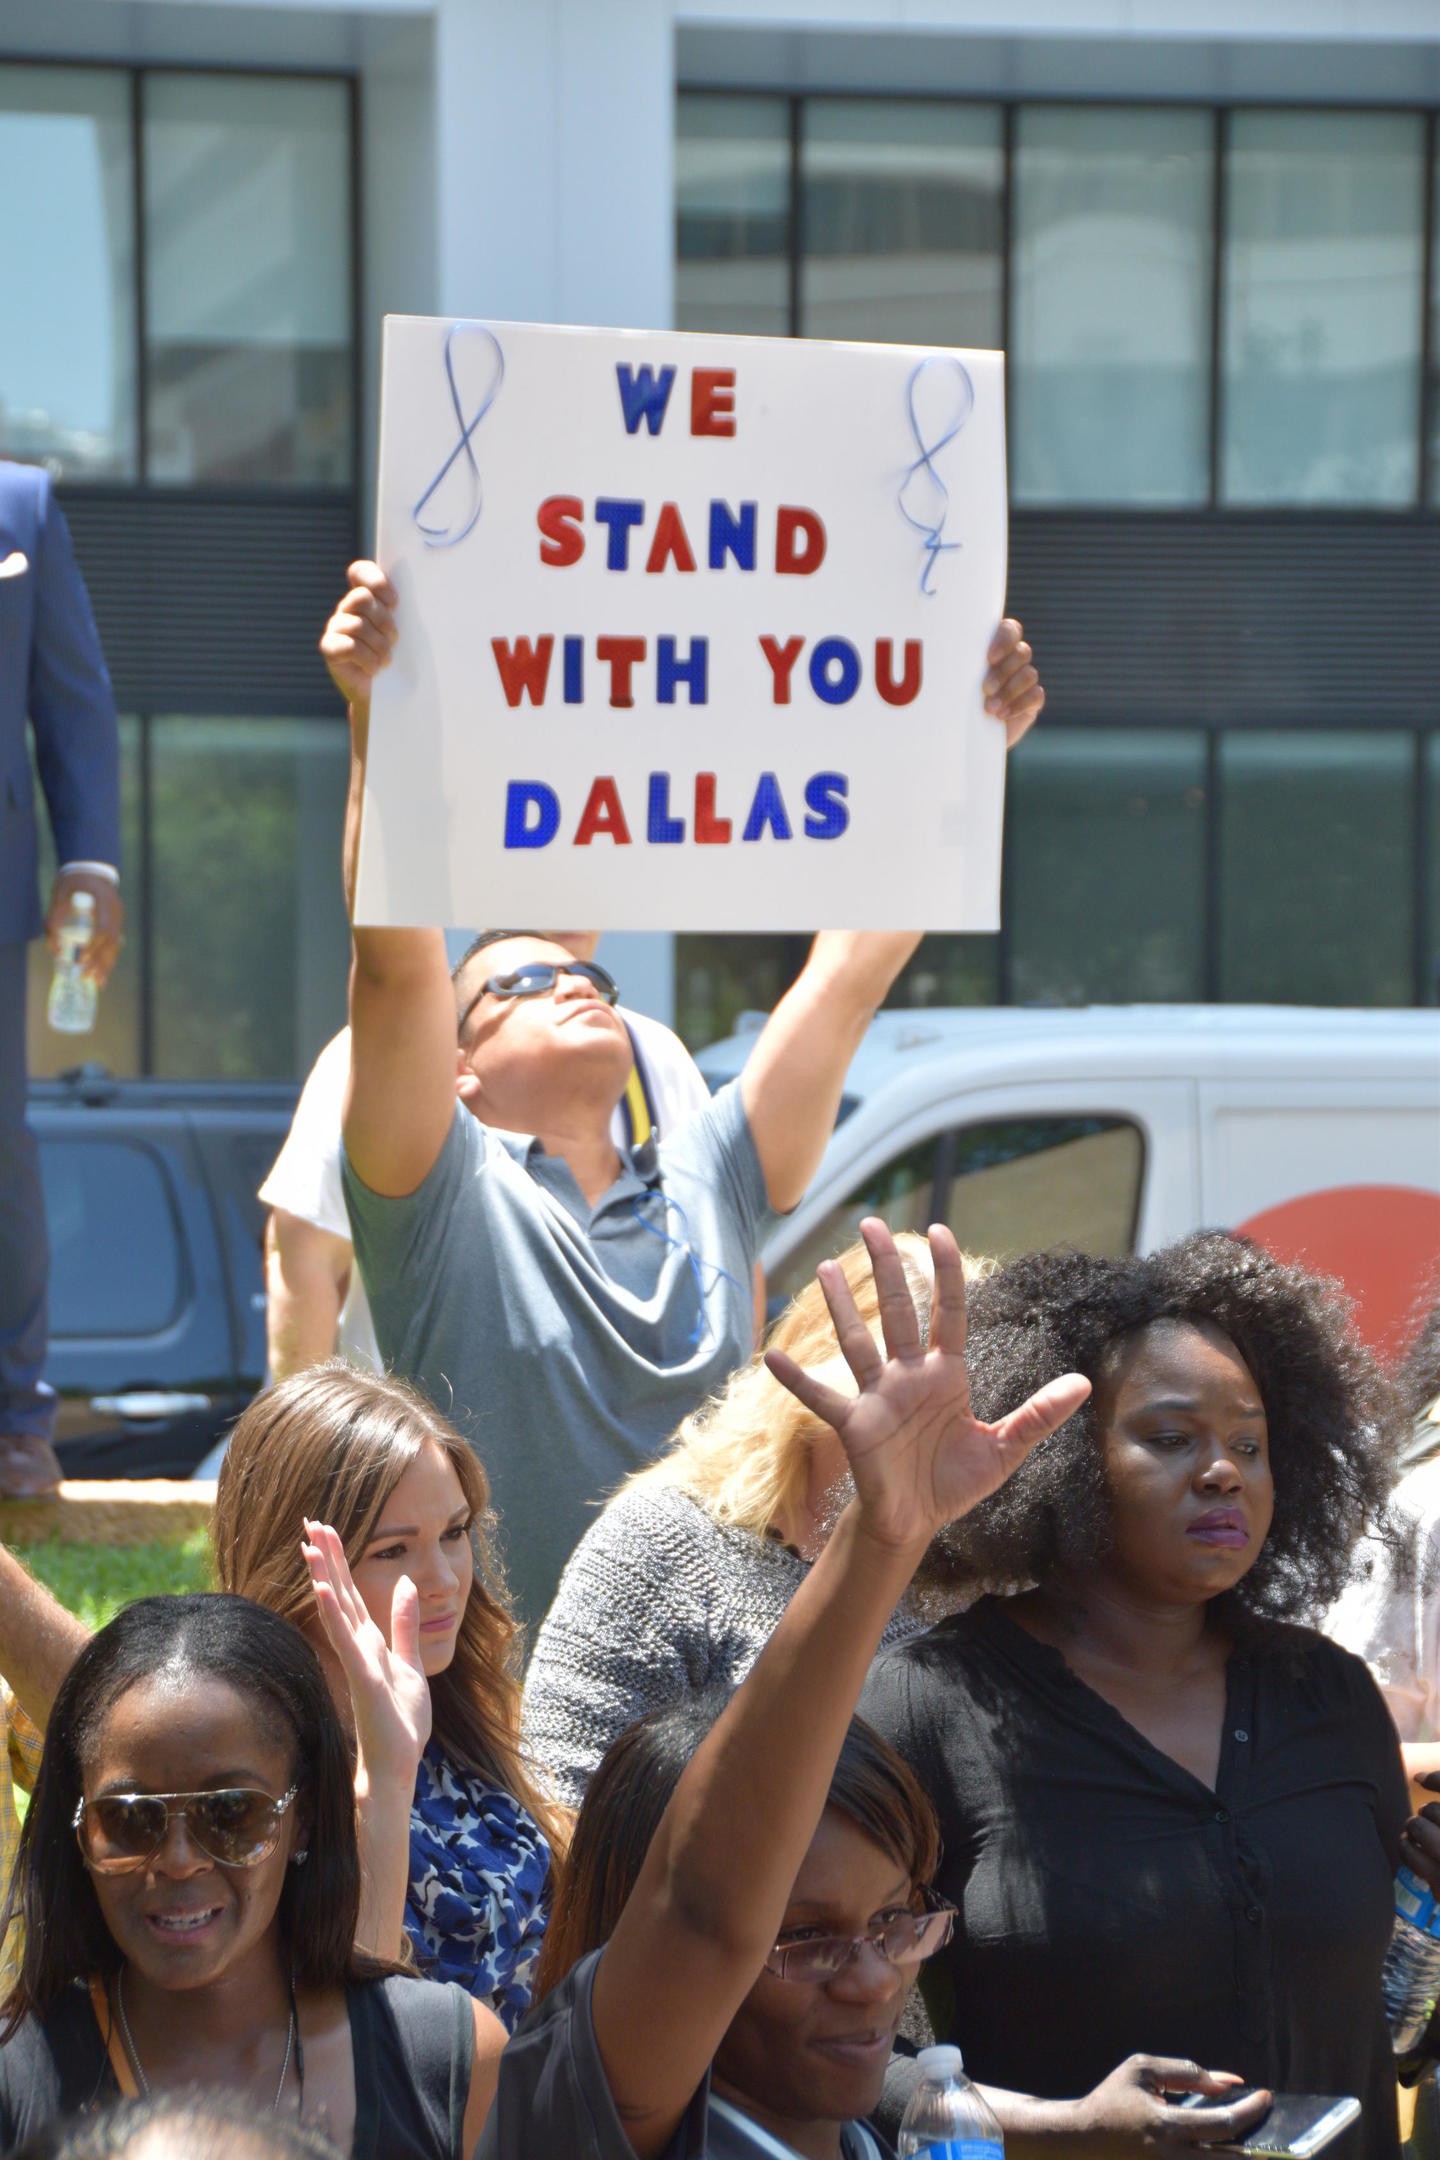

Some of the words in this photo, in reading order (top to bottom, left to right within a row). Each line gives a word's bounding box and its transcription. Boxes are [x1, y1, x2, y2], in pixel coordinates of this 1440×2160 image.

[616, 363, 736, 438] WE
[537, 496, 827, 576] STAND
[491, 635, 709, 709] WITH
[758, 635, 923, 707] YOU
[504, 772, 850, 849] DALLAS
